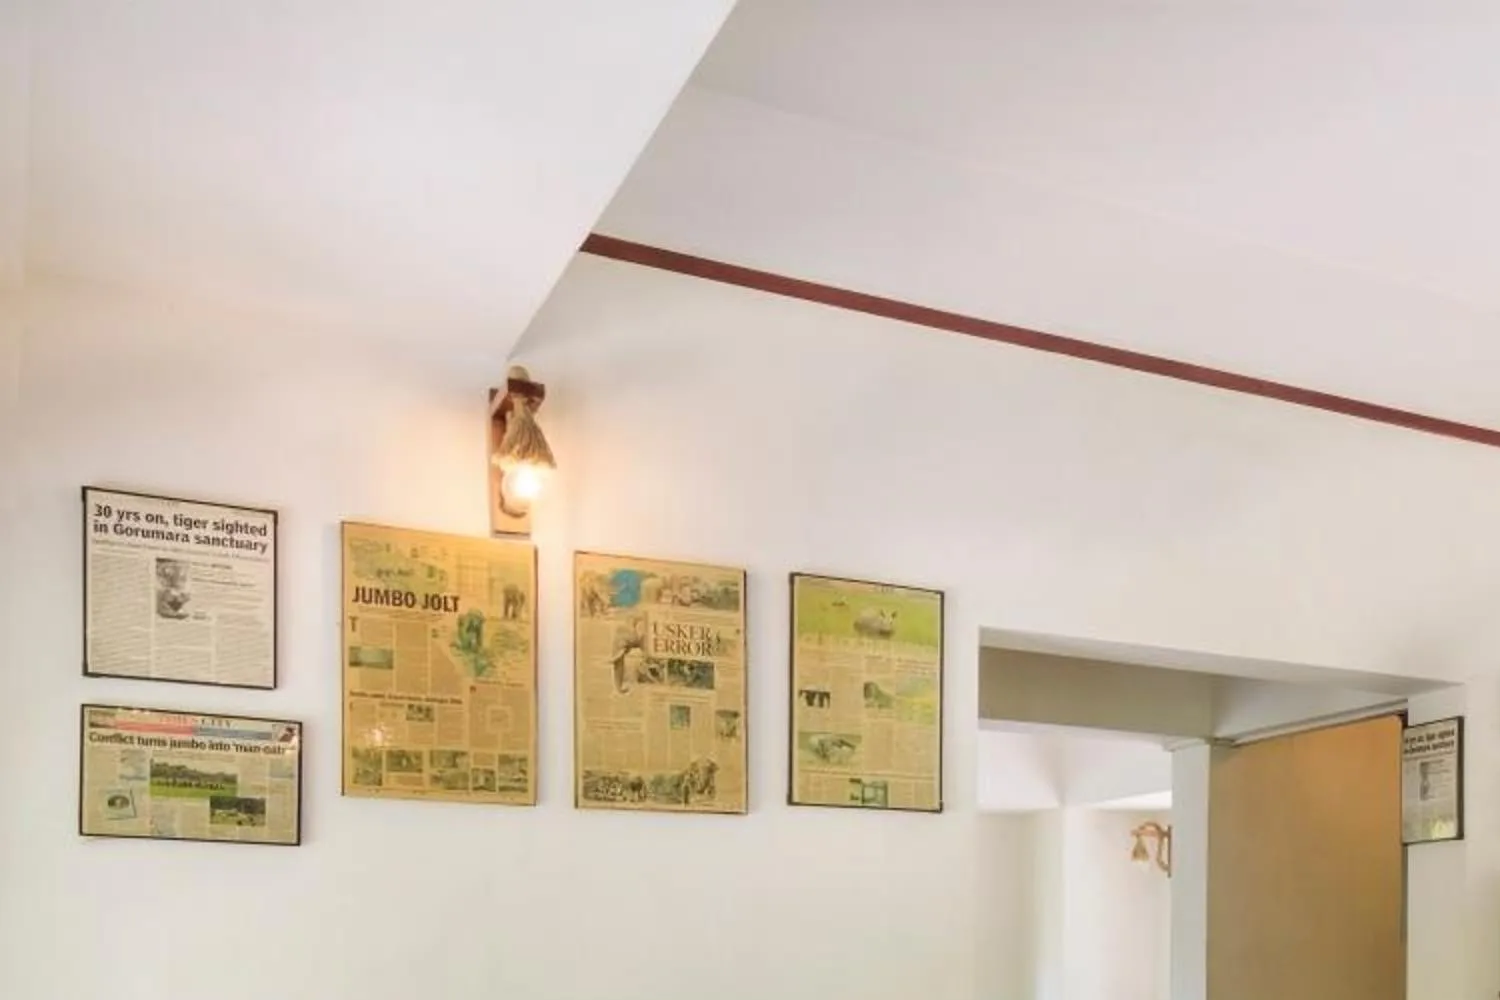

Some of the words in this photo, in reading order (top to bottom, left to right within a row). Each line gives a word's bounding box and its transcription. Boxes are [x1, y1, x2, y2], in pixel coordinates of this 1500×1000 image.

[94, 503, 112, 519] 30
[116, 507, 141, 523] yrs
[145, 514, 169, 527] on,
[173, 513, 208, 532] tiger
[212, 518, 268, 538] sighted
[93, 519, 108, 534] in
[113, 523, 190, 544] Gorumara
[194, 531, 269, 555] sanctuary
[352, 586, 416, 609] JUMBO
[422, 593, 460, 613] JOLT
[89, 731, 135, 746] Conflict
[137, 735, 167, 748] turns
[169, 738, 206, 752] jumbo
[208, 739, 231, 753] into
